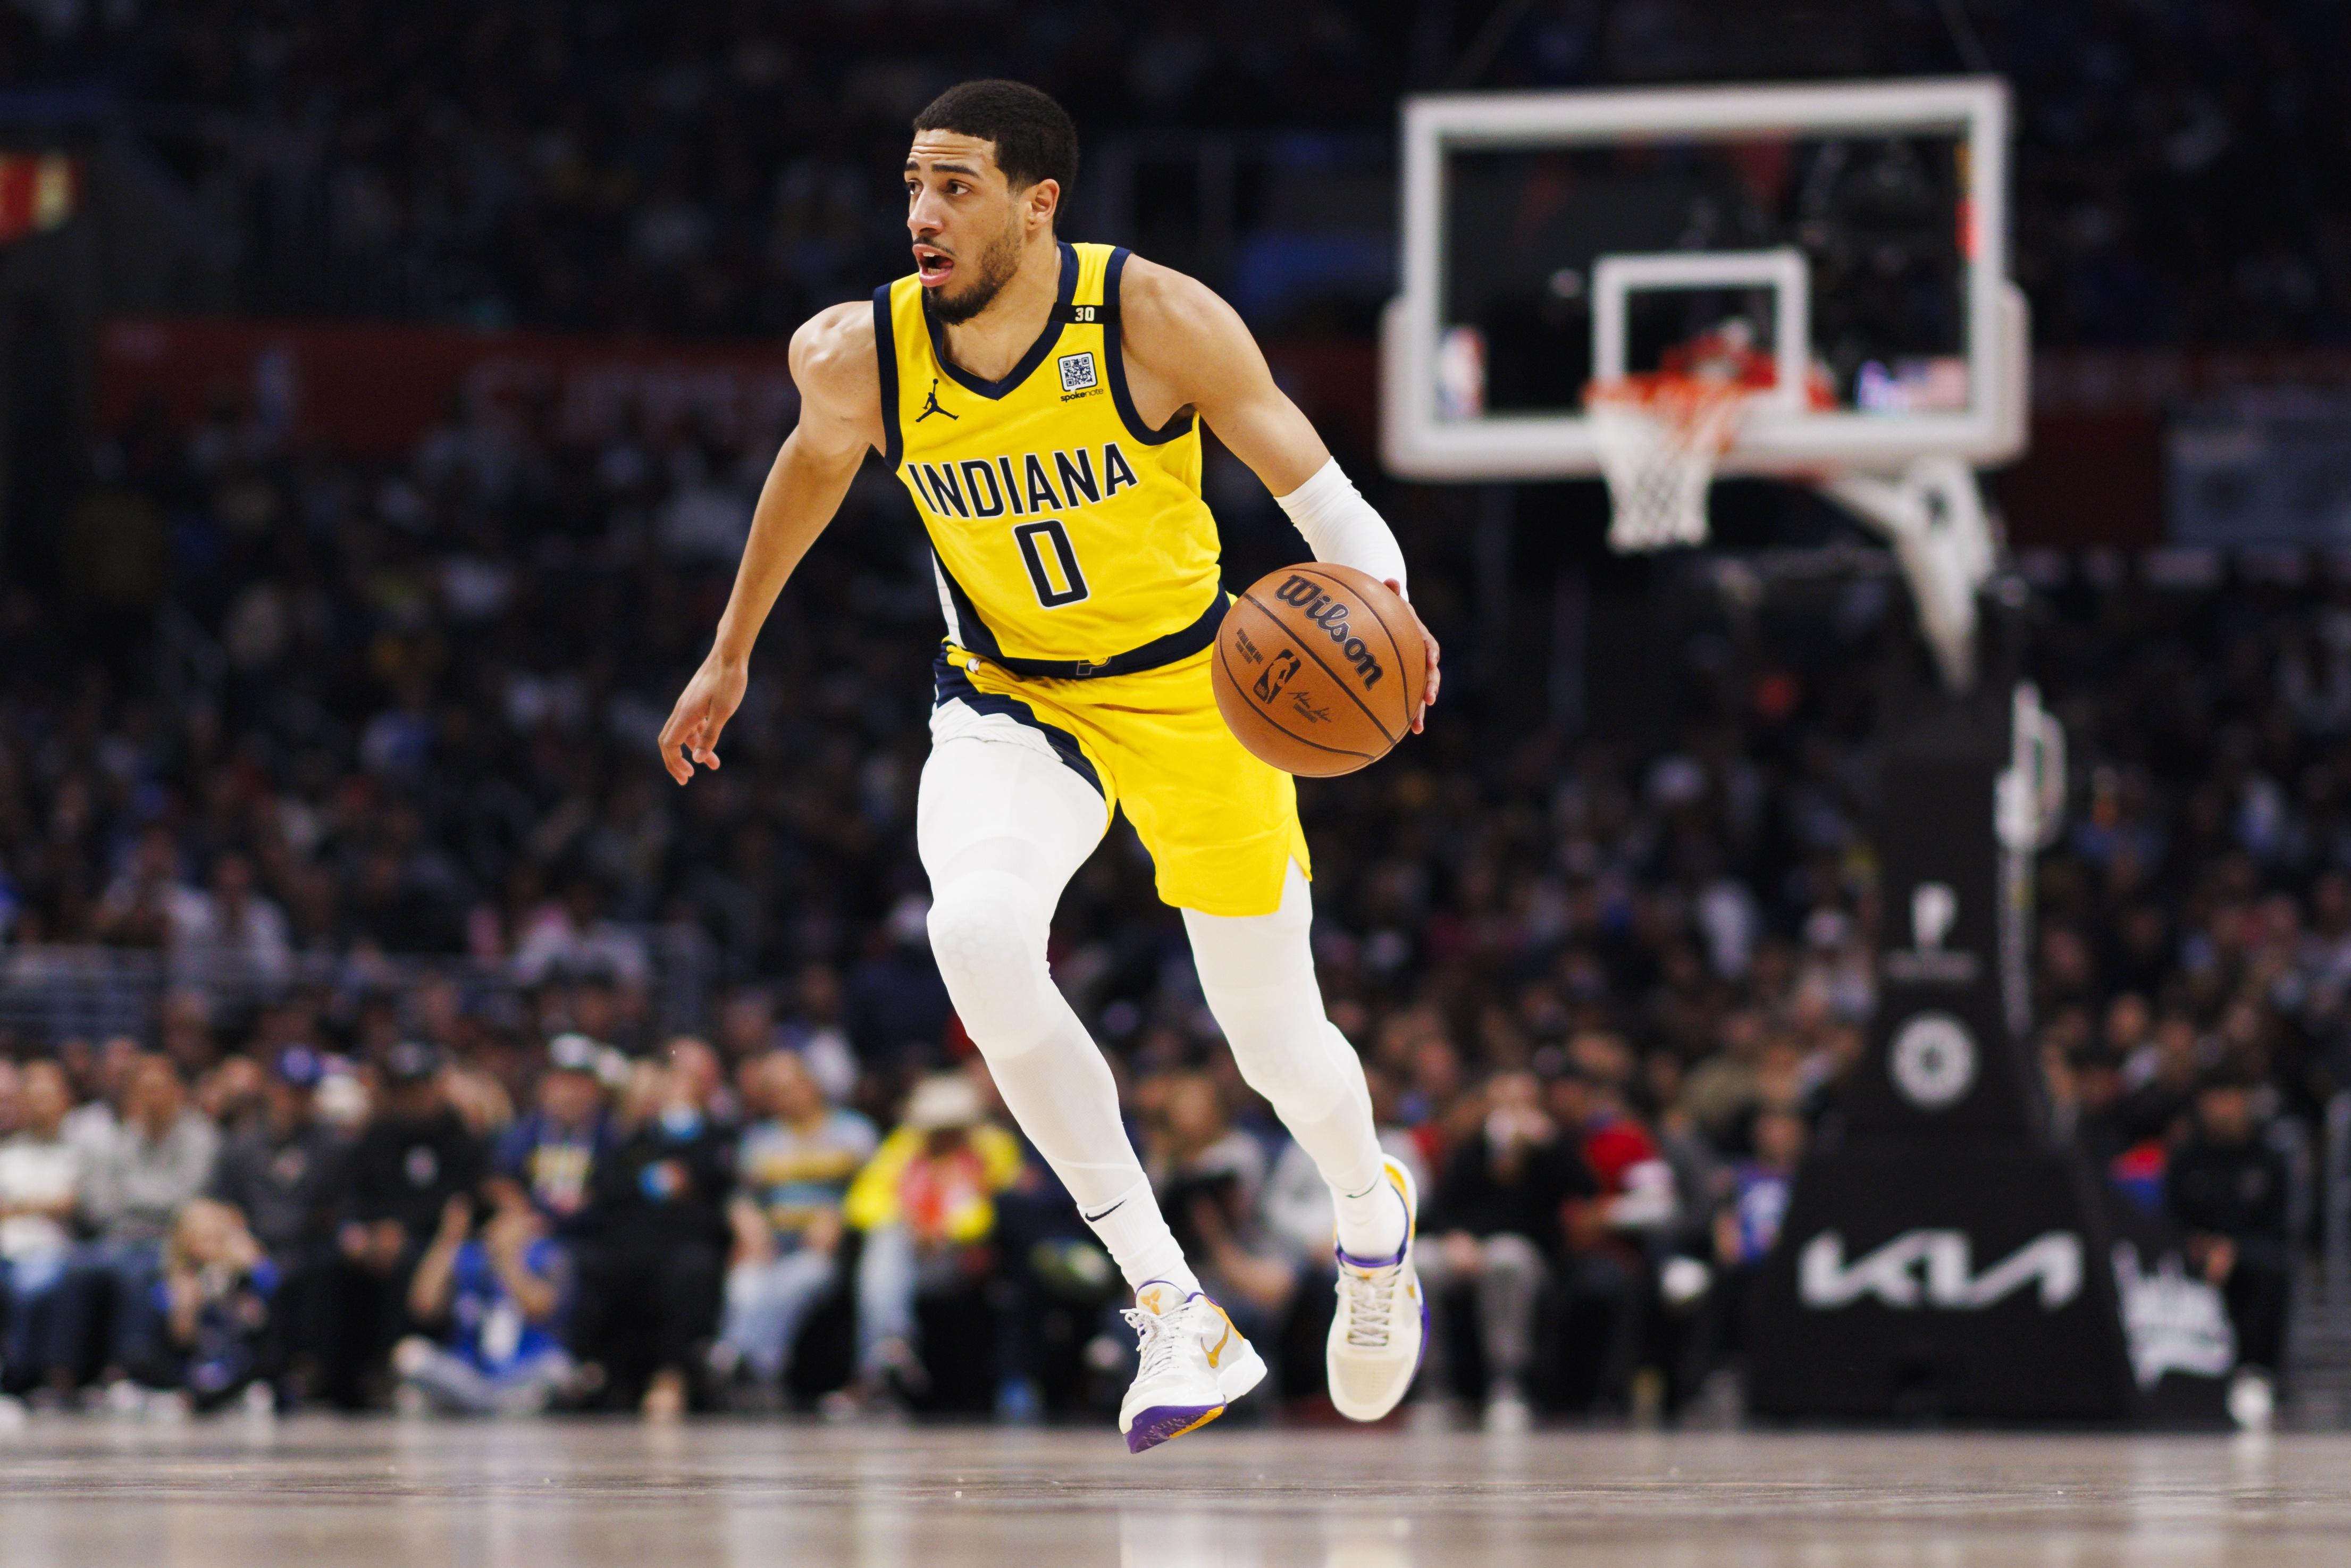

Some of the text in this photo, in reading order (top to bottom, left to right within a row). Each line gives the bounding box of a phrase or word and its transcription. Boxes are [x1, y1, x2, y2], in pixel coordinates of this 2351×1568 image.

[1075, 307, 1095, 322] 30
[1060, 388, 1104, 403] spokenote
[906, 442, 1139, 519] INDIANA
[1012, 518, 1091, 610] 0
[1275, 574, 1383, 691] Wilson
